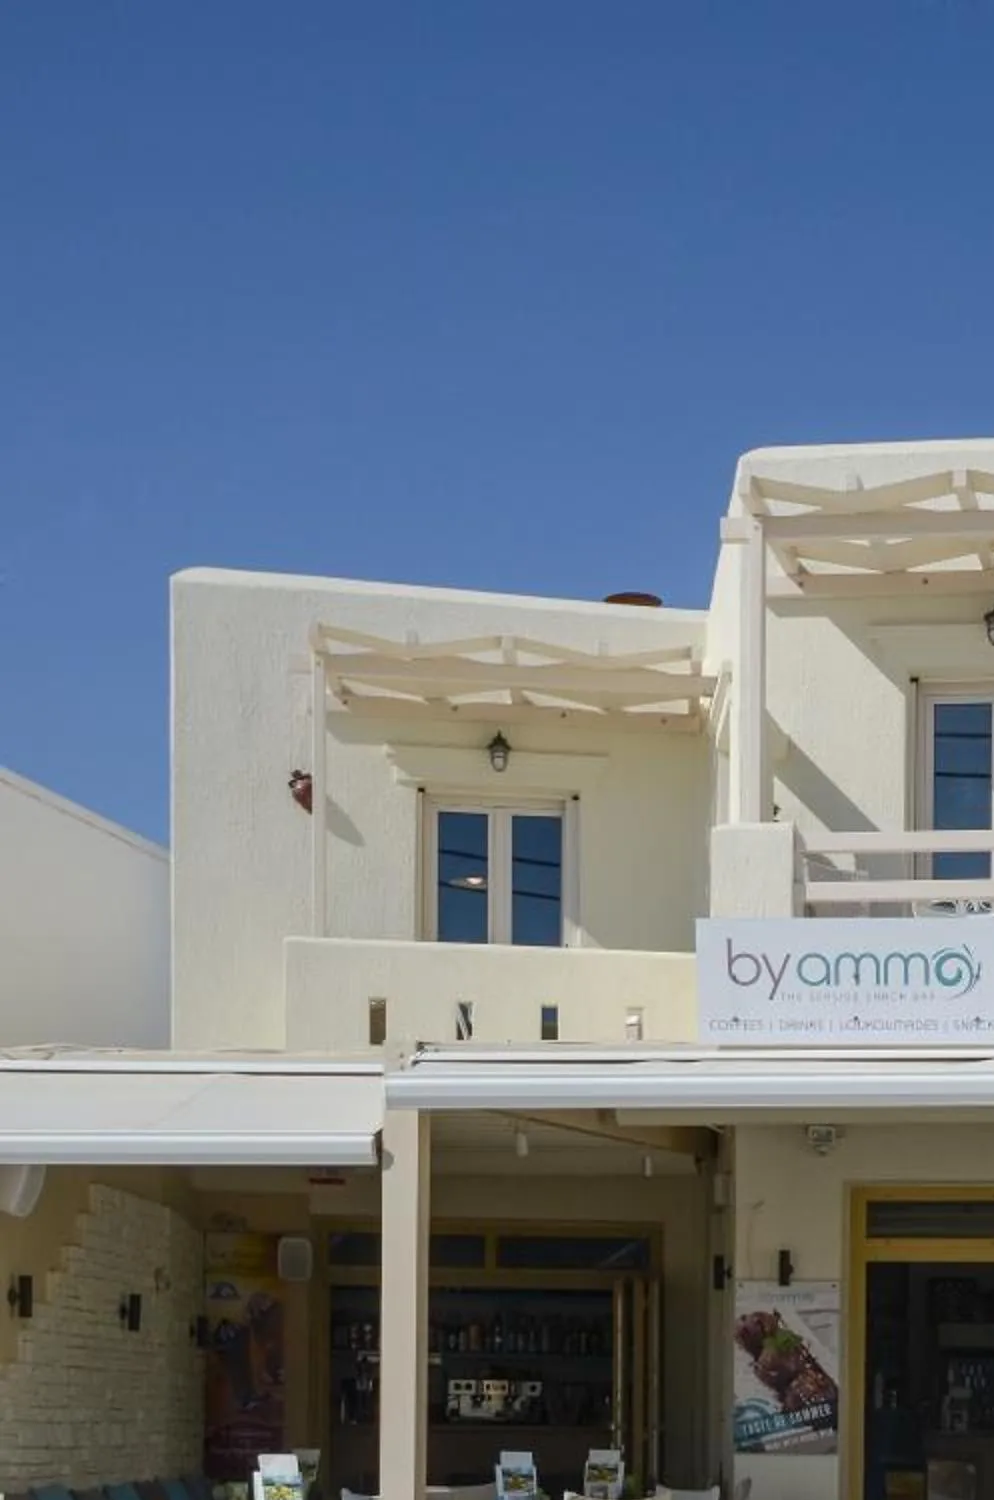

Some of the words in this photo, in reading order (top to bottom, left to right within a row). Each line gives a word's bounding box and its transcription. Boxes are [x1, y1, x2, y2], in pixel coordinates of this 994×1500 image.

[709, 1017, 763, 1031] COFFEES
[779, 1018, 823, 1031] DRINKS
[840, 1017, 938, 1031] LOUKOUMADES
